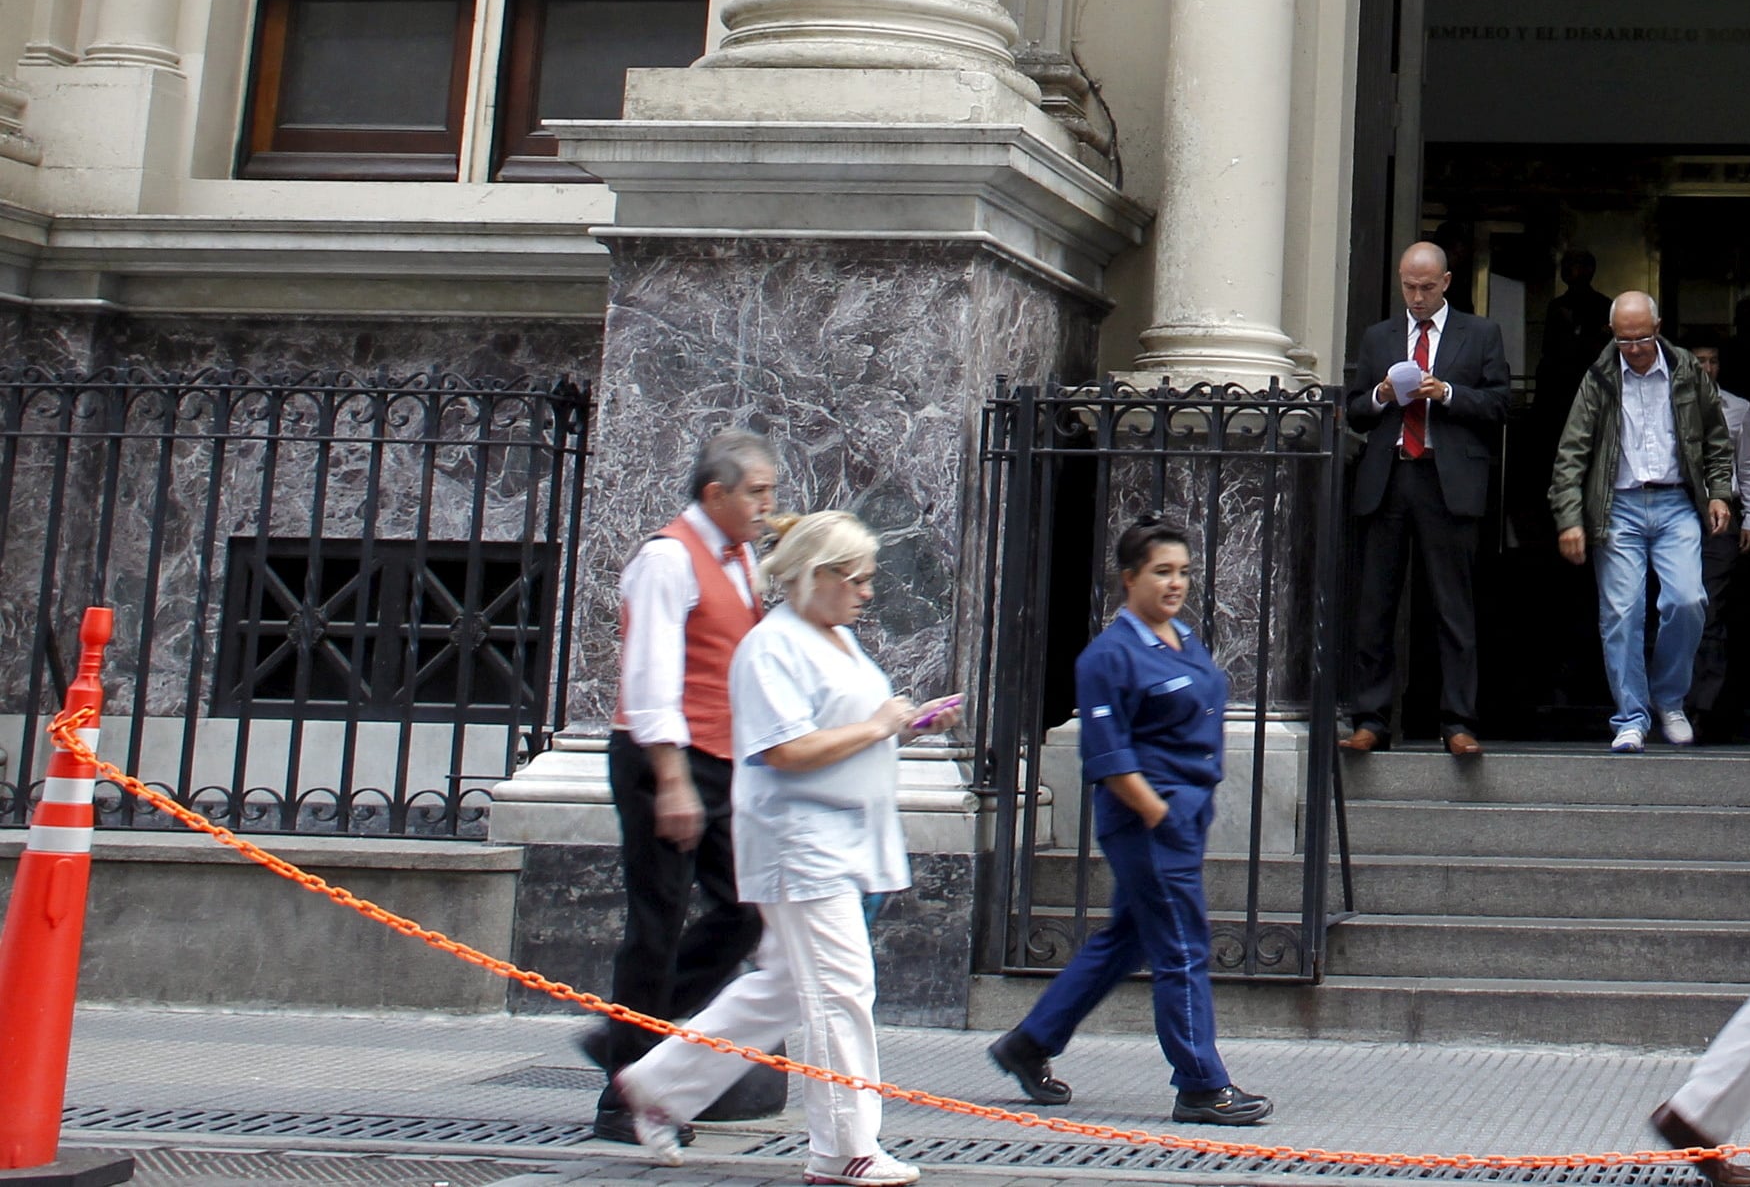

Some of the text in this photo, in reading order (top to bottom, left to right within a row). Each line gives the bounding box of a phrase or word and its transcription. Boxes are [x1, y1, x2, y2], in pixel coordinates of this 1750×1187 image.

[1428, 26, 1510, 41] EMPLEO
[1516, 26, 1529, 40] Y
[1536, 26, 1558, 41] EL
[1564, 26, 1699, 41] DESARROLLO
